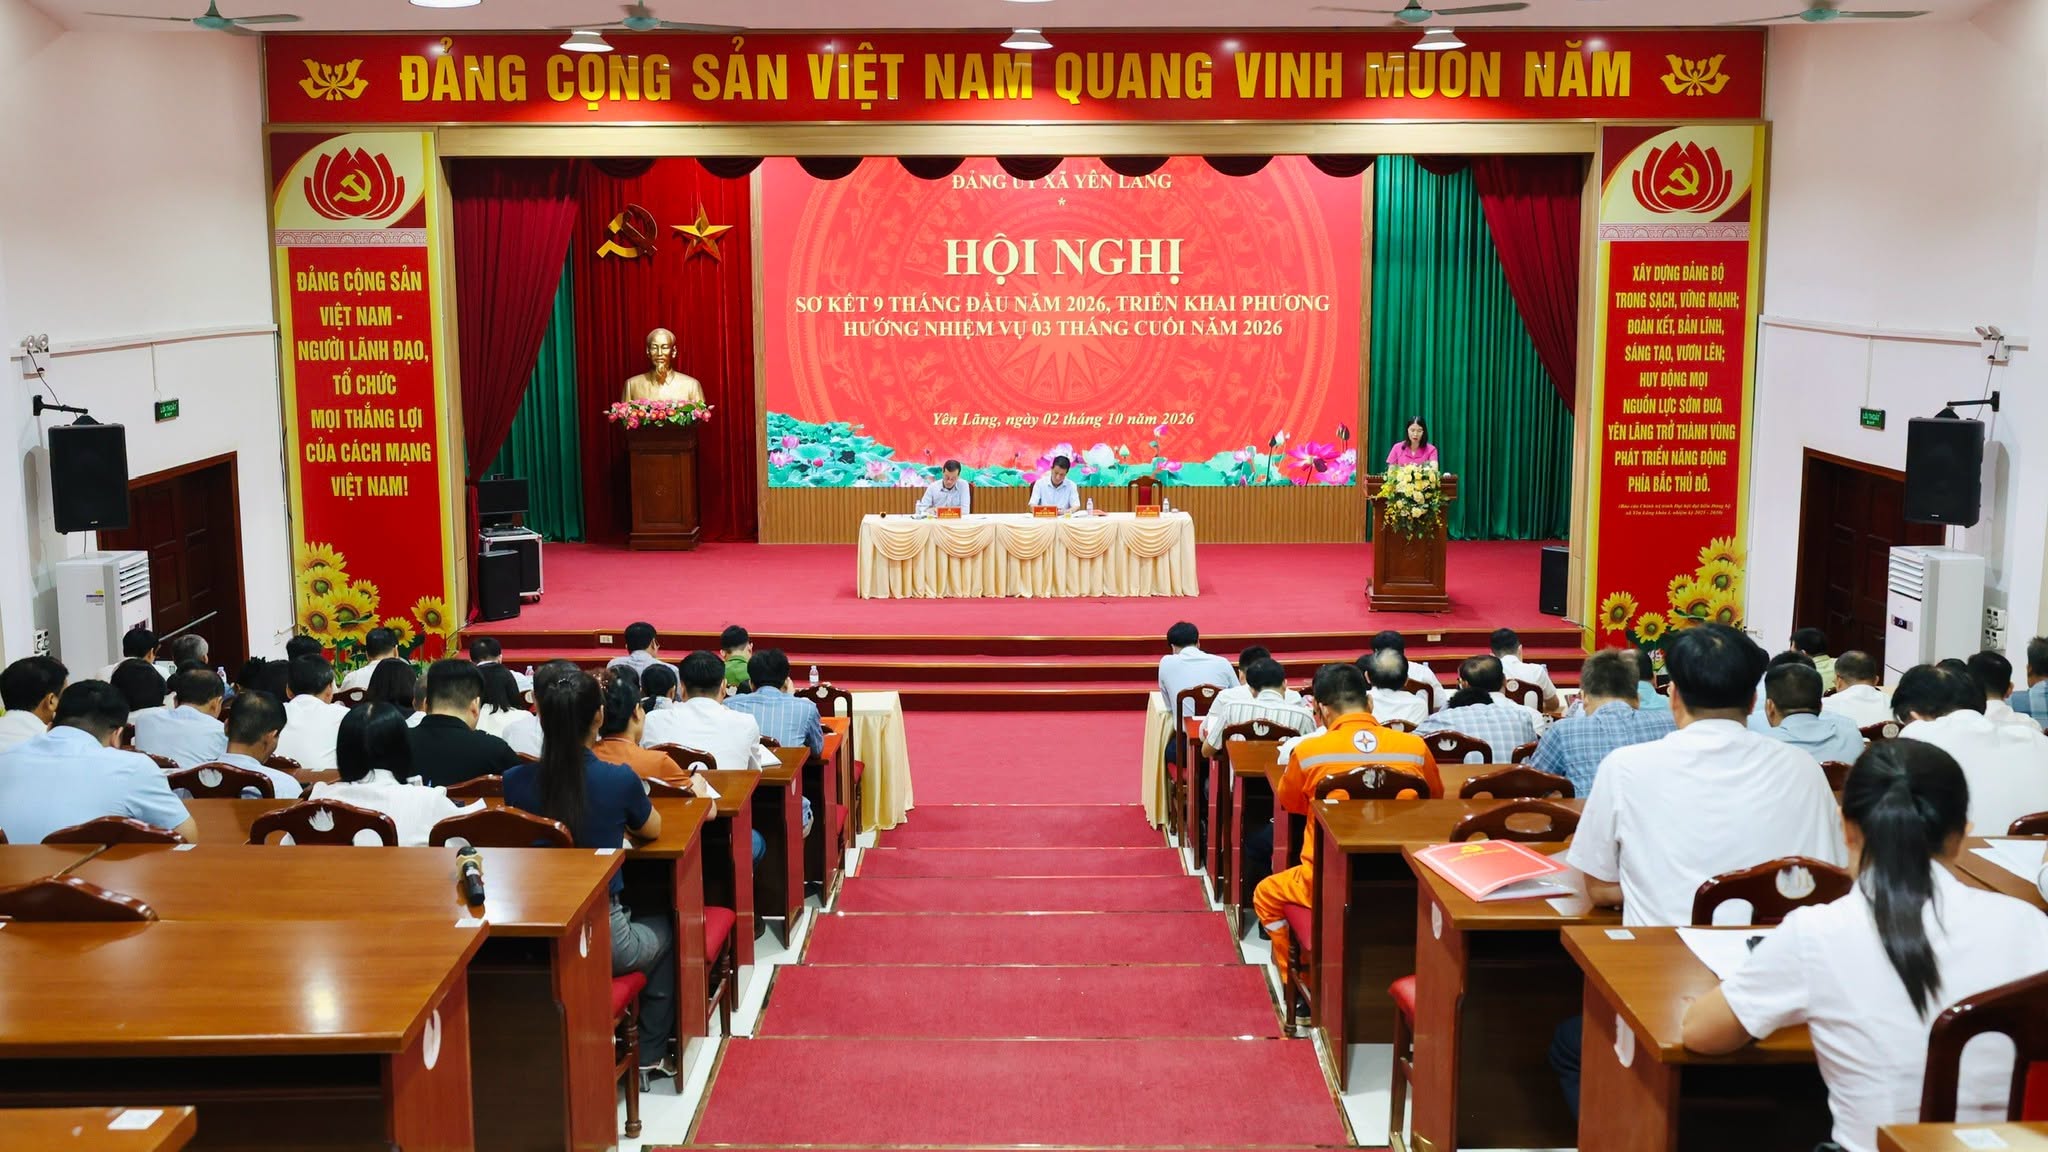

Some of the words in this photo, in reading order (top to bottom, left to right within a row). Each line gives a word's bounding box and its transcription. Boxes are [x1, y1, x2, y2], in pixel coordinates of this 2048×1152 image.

[400, 36, 526, 102] ĐẢNG
[692, 36, 788, 101] SẢN
[807, 41, 904, 111] VIỆT
[924, 52, 1033, 100] NAM
[1054, 51, 1212, 105] QUANG
[1234, 52, 1343, 99] VINH
[1523, 41, 1632, 98] NĂM
[952, 170, 1007, 190] ĐẢNG
[1043, 170, 1070, 189] XÃ
[1073, 169, 1113, 189] YÊN
[943, 233, 1039, 286] HỘI
[1052, 238, 1185, 286] NGHỊ
[297, 265, 339, 291] ĐẢNG
[344, 268, 385, 296] CỘNG
[390, 265, 421, 291] SẢN
[1633, 263, 1651, 281] XÂY
[1654, 264, 1680, 284] DỰNG
[1683, 261, 1708, 281] ĐẢNG
[1712, 262, 1724, 284] BỘ
[795, 295, 823, 313] SƠ
[827, 292, 869, 313] KẾT
[873, 296, 884, 313] 9
[888, 292, 961, 313] THÁNG
[966, 292, 1010, 313] ĐẦU
[1014, 292, 1061, 313] NĂM
[1066, 295, 1112, 315] 2026,
[1183, 295, 1236, 312] KHAI
[1242, 293, 1330, 312] PHƯƠNG
[1616, 292, 1646, 308] TRONG
[1650, 292, 1677, 311] SẠCH,
[1680, 289, 1705, 308] VỮNG
[1708, 292, 1739, 311] MẠNH;
[320, 302, 351, 330] VIỆT
[356, 306, 392, 326] NAM
[1628, 315, 1653, 334] ĐOÀN
[1656, 314, 1675, 336] KẾT,
[1678, 314, 1697, 334] BẢN
[1701, 316, 1724, 335] LĨNH,
[843, 317, 919, 337] HƯỚNG
[924, 318, 993, 341] NHIỆM
[999, 321, 1027, 341] VỤ
[1031, 321, 1051, 337] 03
[1056, 316, 1129, 336] THÁNG
[1134, 315, 1186, 336] CUỐI
[1191, 316, 1238, 336] NĂM
[1242, 319, 1283, 336] 2026
[298, 336, 344, 361] NGƯỜI
[350, 337, 389, 361] LÃNH
[393, 340, 428, 364] ĐẠO,
[1625, 342, 1650, 361] SÁNG
[1654, 346, 1673, 364] TẠO,
[1677, 343, 1701, 361] VƯƠN
[1704, 342, 1725, 362] LÊN;
[333, 367, 351, 395] TỔ
[356, 371, 396, 395] CHỨC
[1640, 372, 1658, 387] HUY
[1661, 369, 1686, 390] ĐỘNG
[1690, 372, 1708, 390] MỌI
[1659, 397, 1676, 416] LỰC
[1679, 395, 1700, 414] SỚM
[1703, 397, 1722, 414] ĐƯA
[311, 409, 340, 433] MỌI
[345, 402, 394, 428] THẮNG
[399, 407, 423, 432] LỢI
[933, 412, 958, 426] Yên
[962, 413, 1001, 428] Lãng,
[1005, 413, 1039, 428] ngày
[1043, 413, 1060, 426] 02
[1063, 412, 1103, 428] tháng
[1106, 412, 1123, 425] 10
[1126, 412, 1156, 425] năm
[1161, 412, 1195, 425] 2026
[1608, 422, 1626, 440] YÊN
[1629, 422, 1653, 440] LÃNG
[1656, 420, 1675, 440] TRỞ
[1677, 421, 1708, 440] THÀNH
[1711, 421, 1735, 440] VÙNG
[306, 437, 336, 462] CỦA
[341, 439, 381, 462] CÁCH
[386, 443, 431, 466] MẠNG
[1615, 448, 1639, 466] PHÁT
[1642, 444, 1668, 465] TRIỂN
[1671, 448, 1697, 465] NĂNG
[1701, 448, 1726, 468] ĐỘNG
[331, 472, 362, 501] VIỆT
[368, 476, 408, 496] NAM!
[1629, 473, 1650, 492] PHÍA
[1653, 471, 1672, 492] BẮC
[1675, 471, 1693, 492] THỦ
[1695, 473, 1710, 492] ĐÔ.
